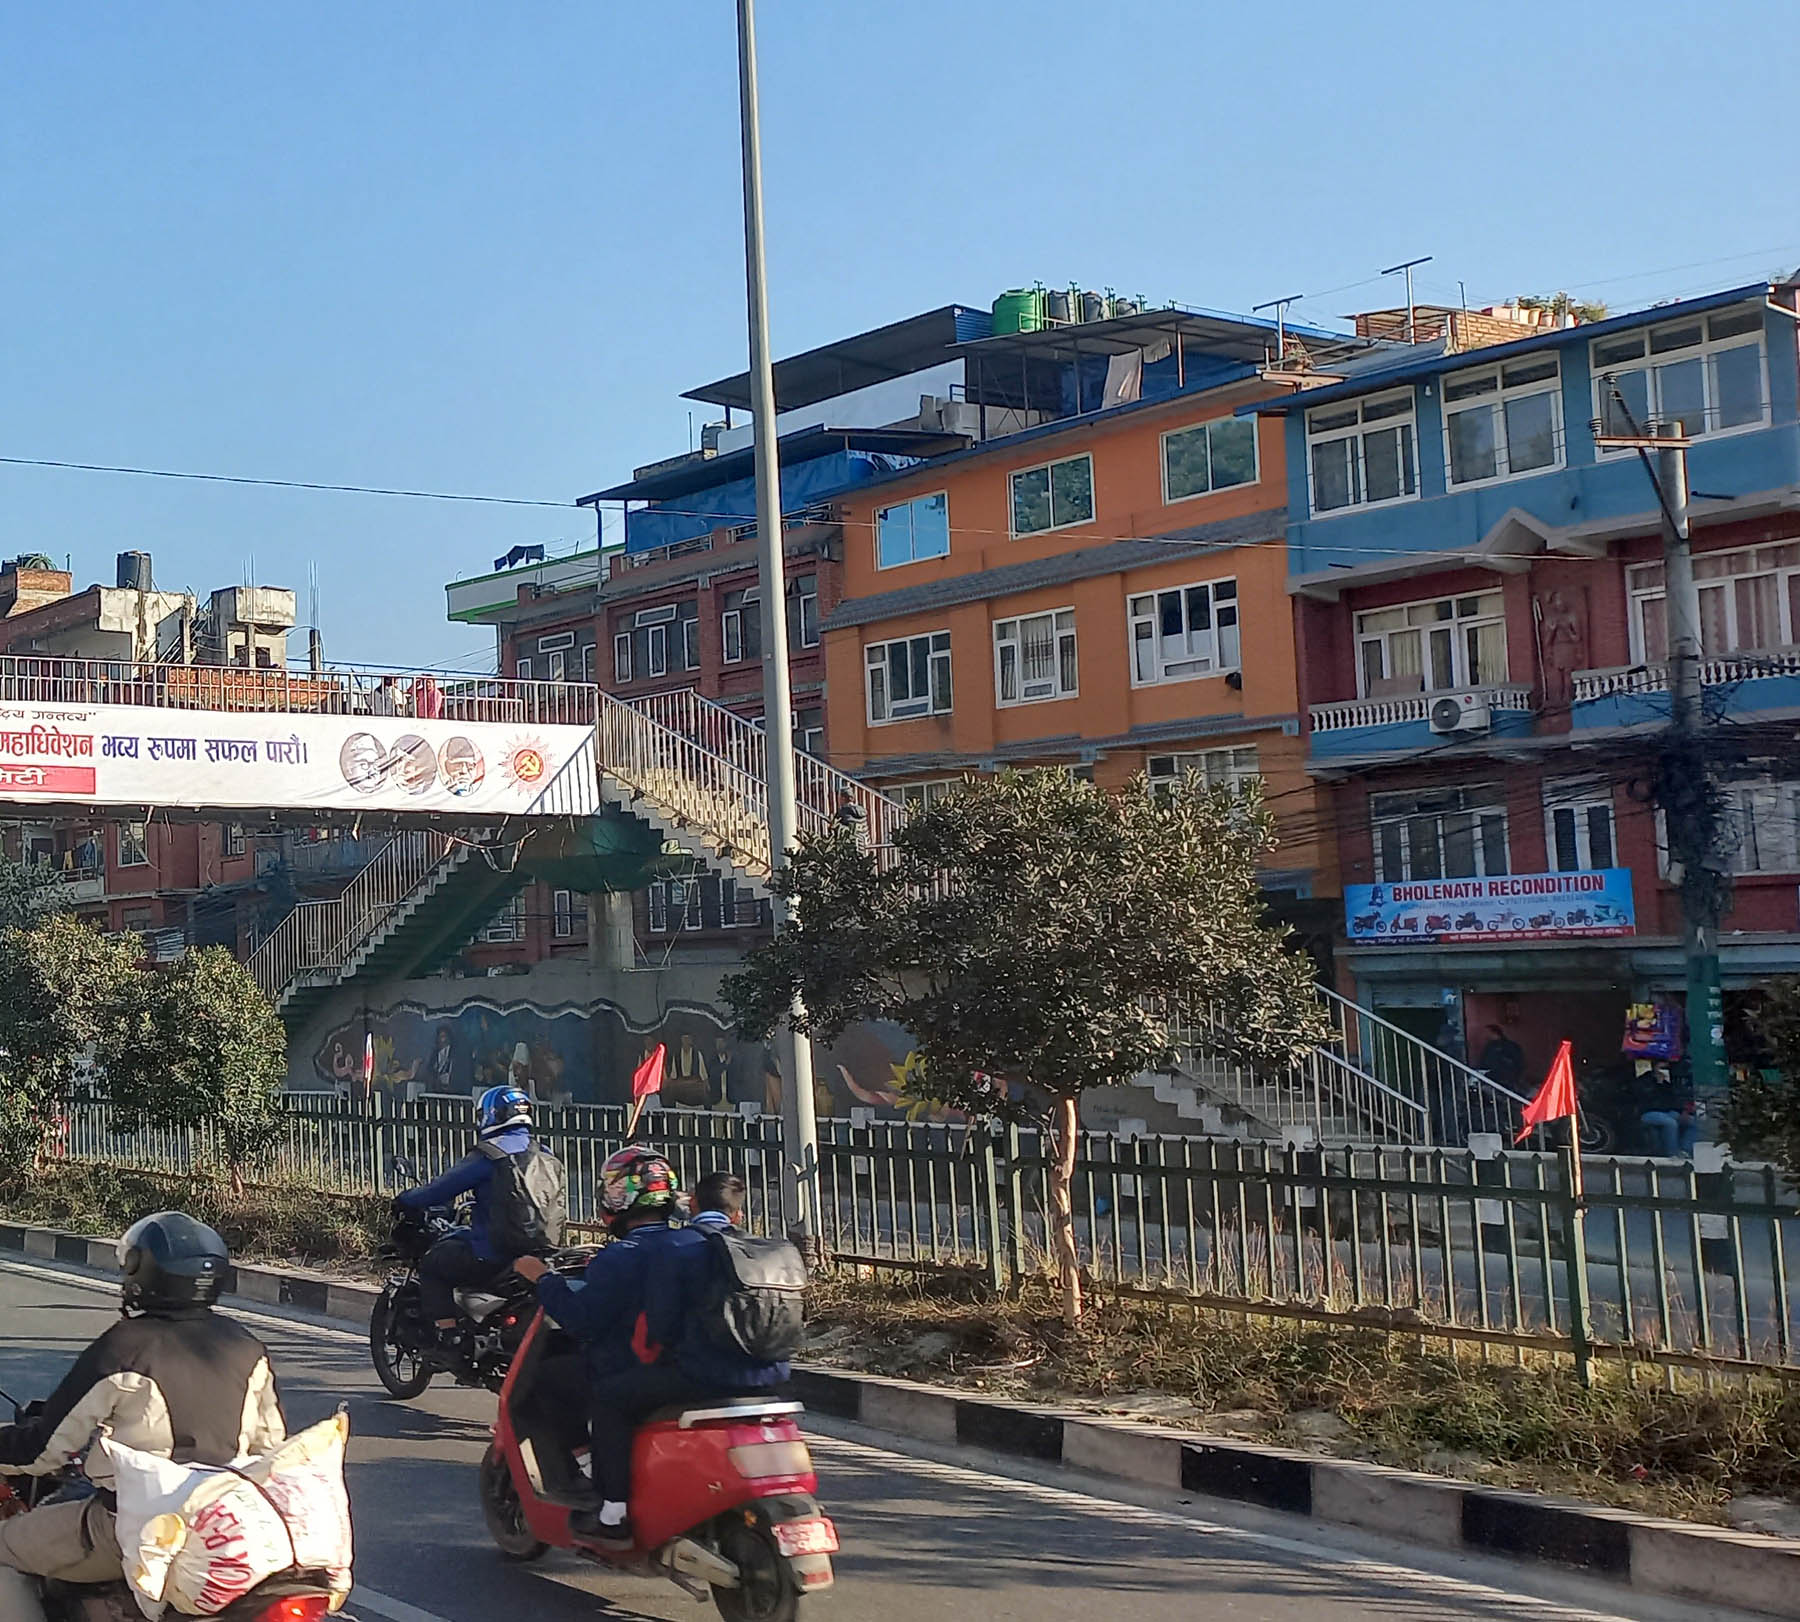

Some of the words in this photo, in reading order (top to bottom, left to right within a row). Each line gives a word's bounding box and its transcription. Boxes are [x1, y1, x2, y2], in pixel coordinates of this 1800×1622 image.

[101, 735, 140, 759] भव्य
[147, 737, 198, 761] रूपमा
[204, 739, 258, 763] सफल
[1392, 881, 1483, 902] BHOLENATH
[1488, 874, 1604, 896] RECONDITION
